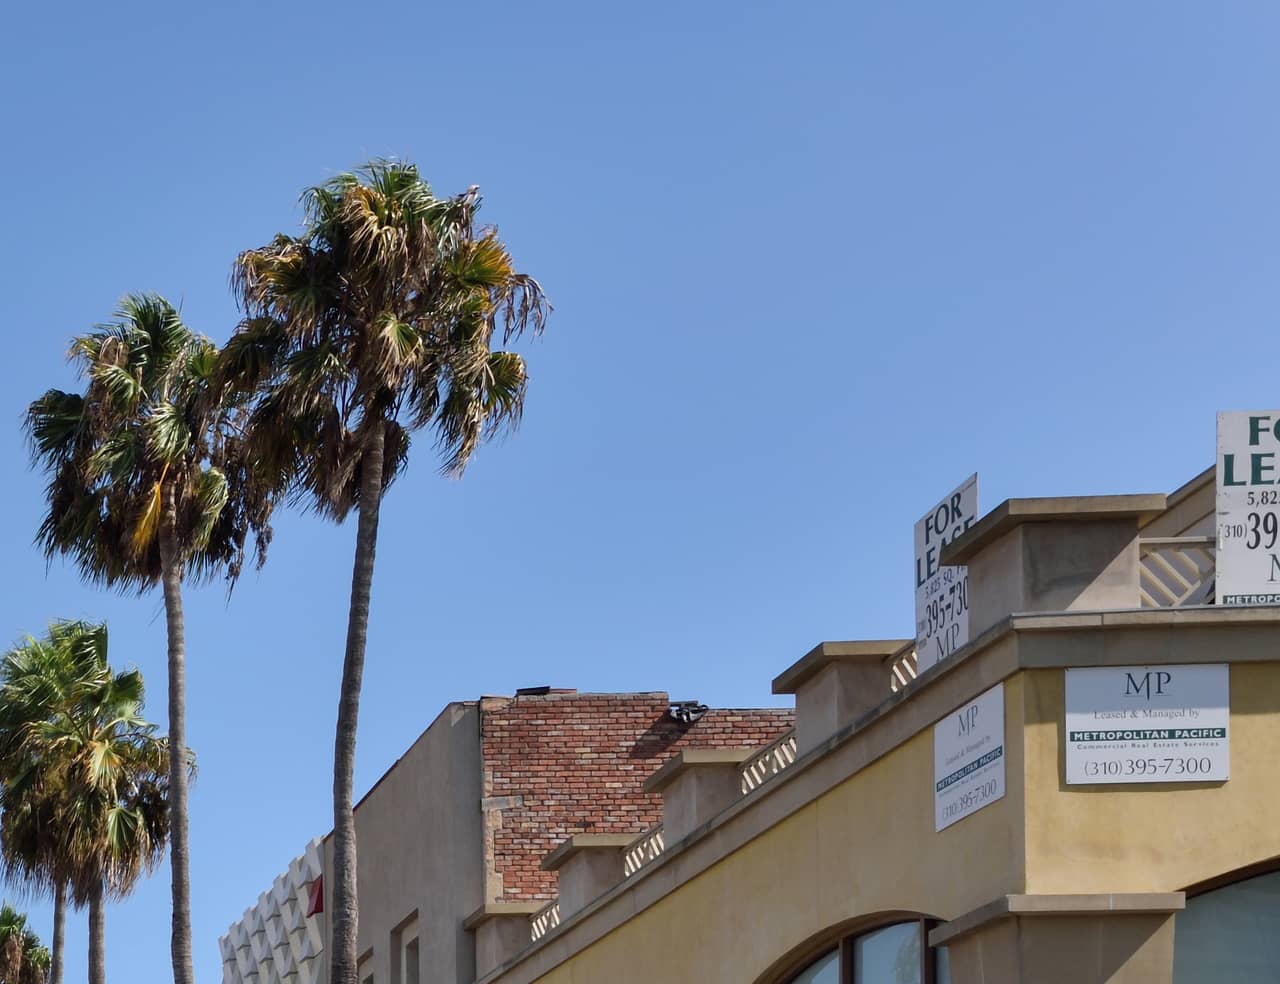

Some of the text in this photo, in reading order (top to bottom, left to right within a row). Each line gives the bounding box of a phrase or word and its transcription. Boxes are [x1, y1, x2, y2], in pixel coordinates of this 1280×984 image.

[1248, 415, 1280, 446] F
[1223, 451, 1280, 487] LE
[1247, 489, 1280, 507] 5,82
[925, 492, 963, 545] FOR
[1246, 511, 1279, 550] 39
[925, 576, 968, 639] 395-730
[936, 622, 959, 662] MP
[1124, 671, 1172, 700] MP
[958, 704, 978, 736] MP
[1093, 708, 1200, 721] Leased & Managed by
[1074, 728, 1222, 741] METROPOLITAN PACIFIC
[1077, 742, 1127, 750] Commercial
[1083, 757, 1212, 776] (310) 395-7300
